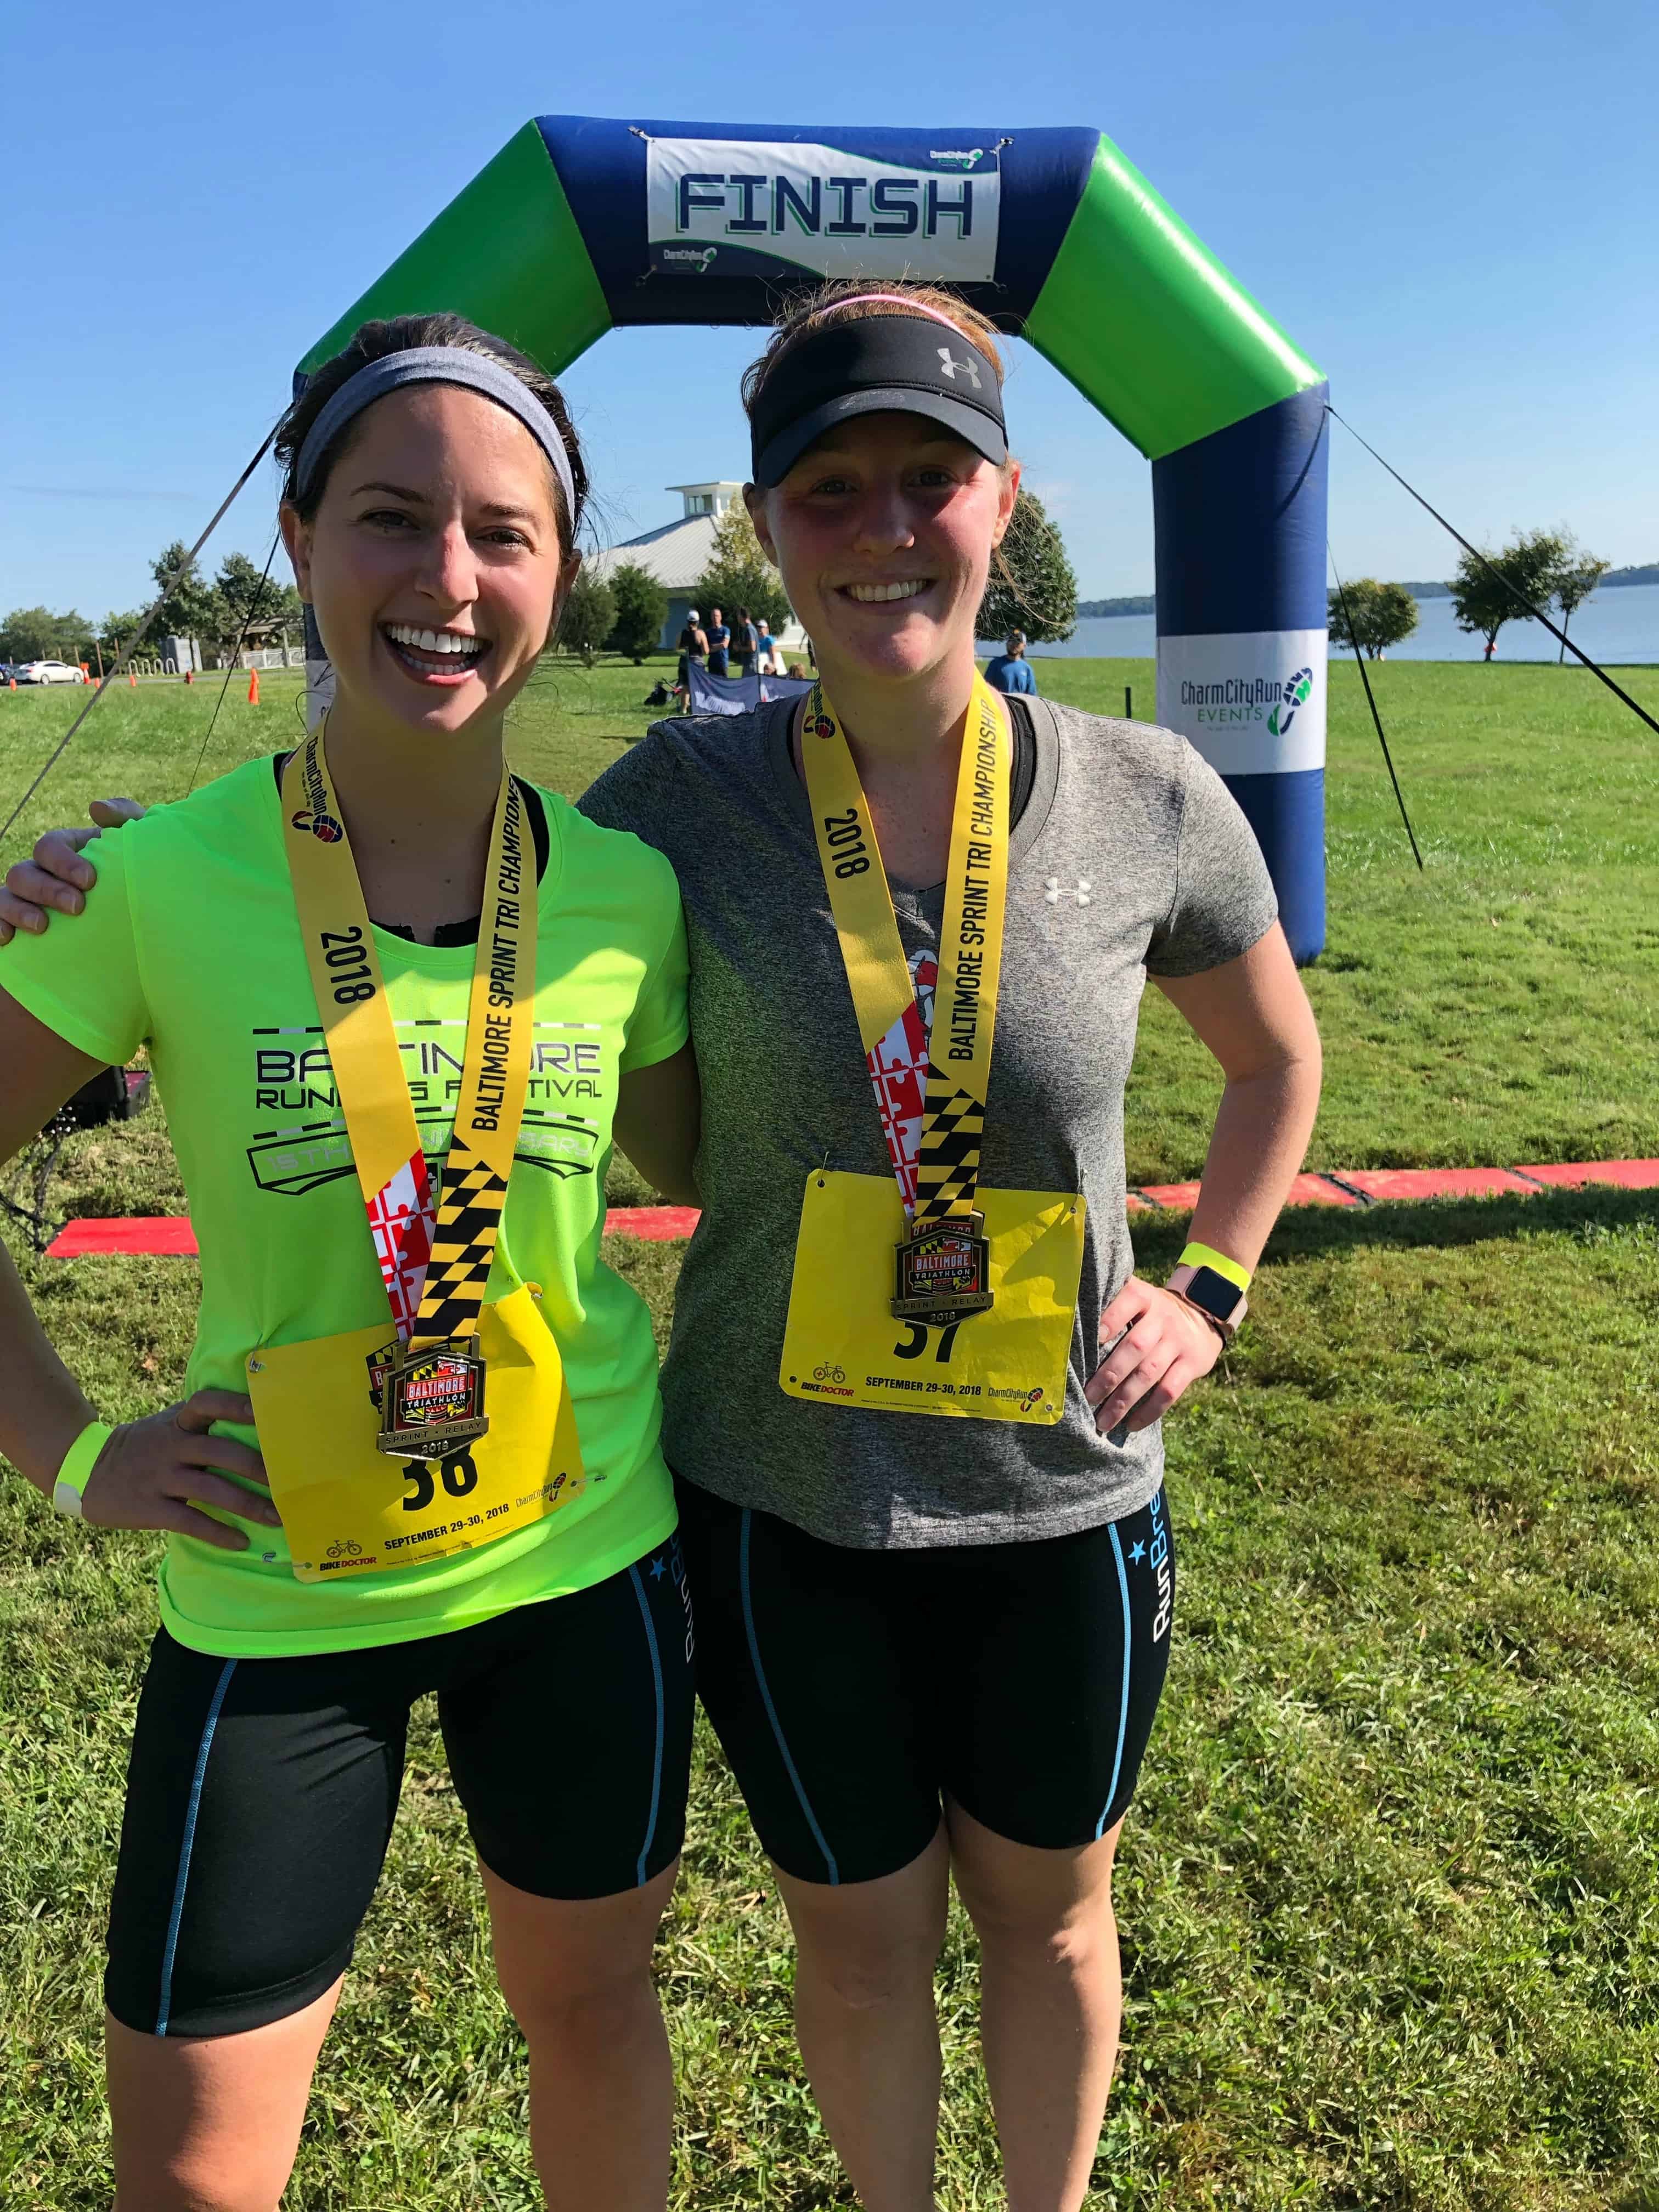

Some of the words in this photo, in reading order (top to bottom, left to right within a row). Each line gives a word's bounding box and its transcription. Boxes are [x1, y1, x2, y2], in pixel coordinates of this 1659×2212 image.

[676, 173, 972, 240] FINISH
[1181, 679, 1282, 707] CharmCityRun
[1198, 708, 1263, 722] EVENTS
[970, 699, 997, 837] CHAMPIONSHIP
[825, 808, 870, 879] 2018
[967, 842, 991, 871] TRI
[496, 897, 521, 936] TRI
[961, 875, 989, 945] SPRINT
[320, 926, 375, 1005] 2018
[488, 933, 517, 1009] SPRINT
[949, 950, 983, 1061] BALTIMORE
[471, 1013, 512, 1131] BALTIMORE
[445, 1080, 602, 1099] FTIVAL
[916, 1269, 970, 1279] TRIATHLON
[917, 1255, 969, 1270] BALTIMORE
[896, 1301, 935, 1311] SPRINT
[952, 1296, 986, 1305] RELAY
[930, 1312, 956, 1322] 2018
[409, 1376, 465, 1398] BALTIMORE
[866, 1376, 923, 1391] SEPTEMBER
[926, 1383, 956, 1396] 29-30,
[959, 1385, 981, 1395] 2018
[408, 1393, 466, 1408] TRIATHLON
[386, 1431, 428, 1444] SPRINT
[445, 1422, 481, 1434] RELAY
[421, 1440, 448, 1454] 2018
[385, 1526, 448, 1550] SEPTEMBER
[450, 1515, 483, 1533] 29-30,
[486, 1503, 509, 1520] 2018
